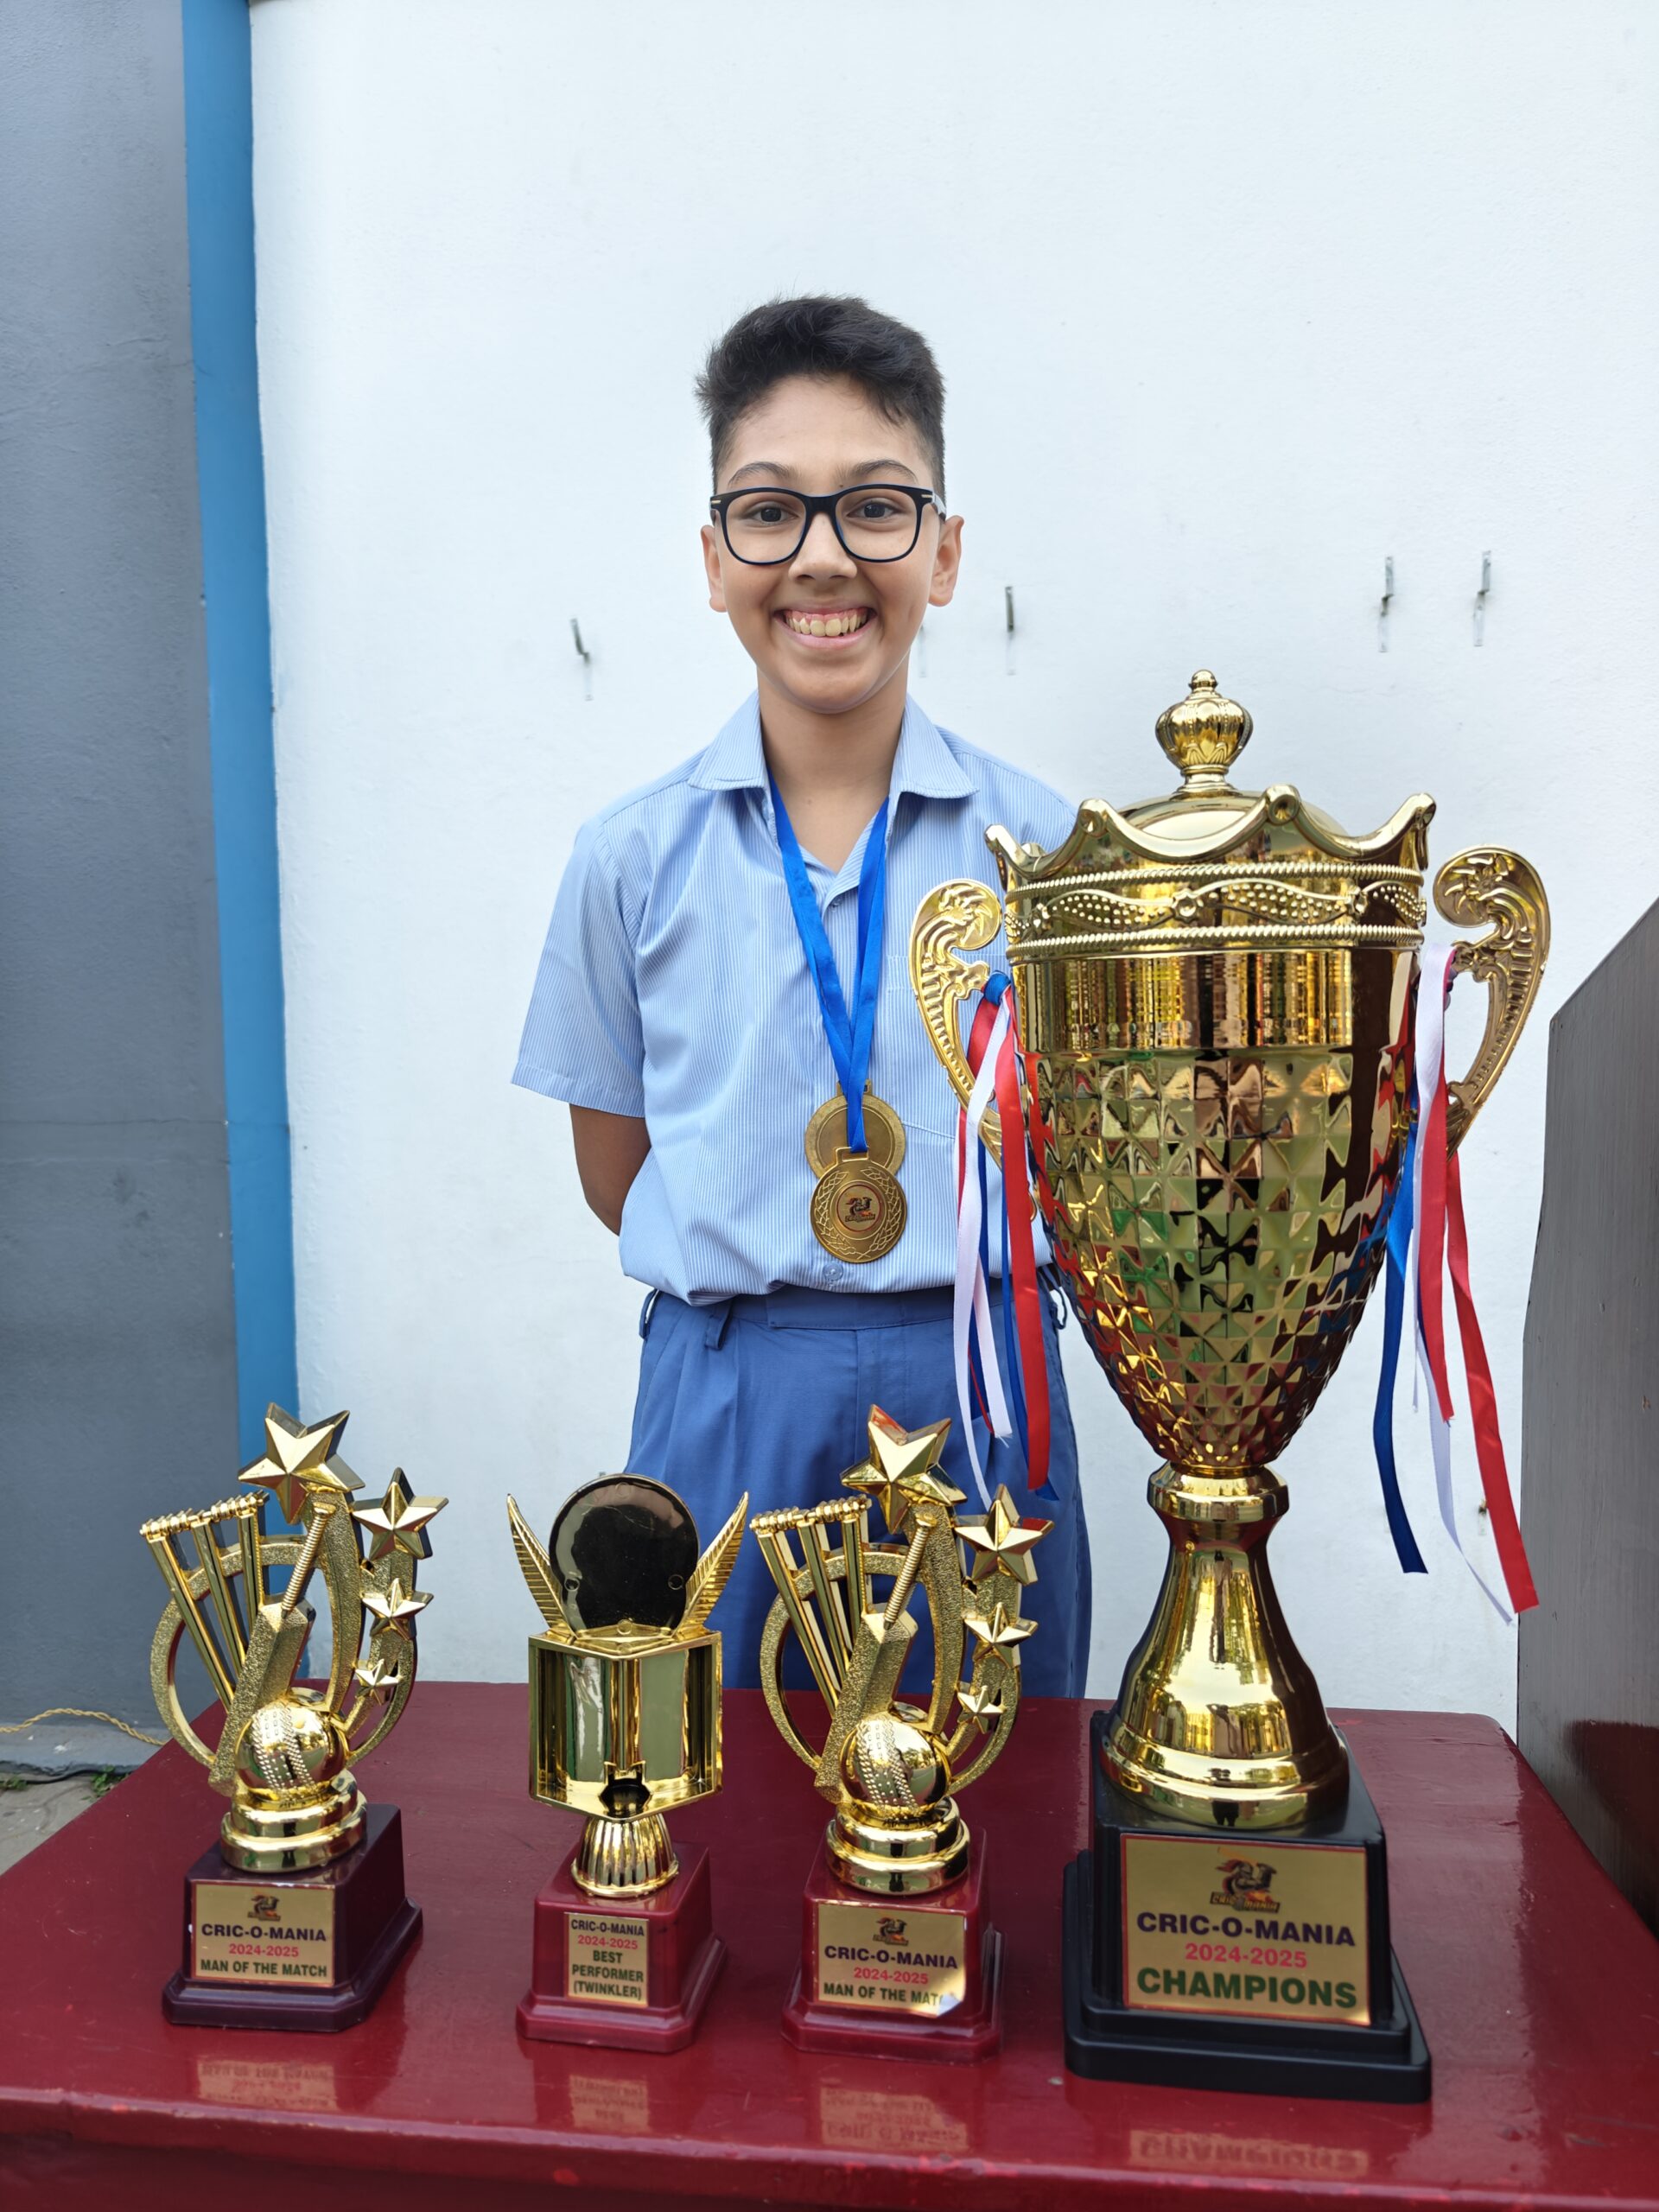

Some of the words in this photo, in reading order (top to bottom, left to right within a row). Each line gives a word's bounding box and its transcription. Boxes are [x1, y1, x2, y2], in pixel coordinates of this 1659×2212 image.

[201, 1923, 327, 1942] CRIC-O-MANIA
[571, 1919, 645, 1936] CRIC-O-MANIA
[1136, 1911, 1356, 1947] CRIC-O-MANIA
[229, 1943, 299, 1957] 2024-2025
[578, 1935, 638, 1949] 2024-2025
[593, 1950, 623, 1963] BEST
[824, 1945, 958, 1969] CRIC-O-MANIA
[1185, 1942, 1307, 1968] 2024-2025
[200, 1959, 229, 1972] MAN
[232, 1961, 249, 1973] OF
[253, 1961, 277, 1974] THE
[282, 1964, 327, 1977] MATCH
[572, 1964, 644, 1982] PERFORMER
[854, 1967, 929, 1985] 2024-2025
[574, 1980, 642, 2000] (TWINKLER)
[823, 1982, 854, 1997] MAN
[858, 1986, 876, 1999] OF
[880, 1988, 906, 2001] THE
[1136, 1967, 1357, 2009] CHAMPIONS
